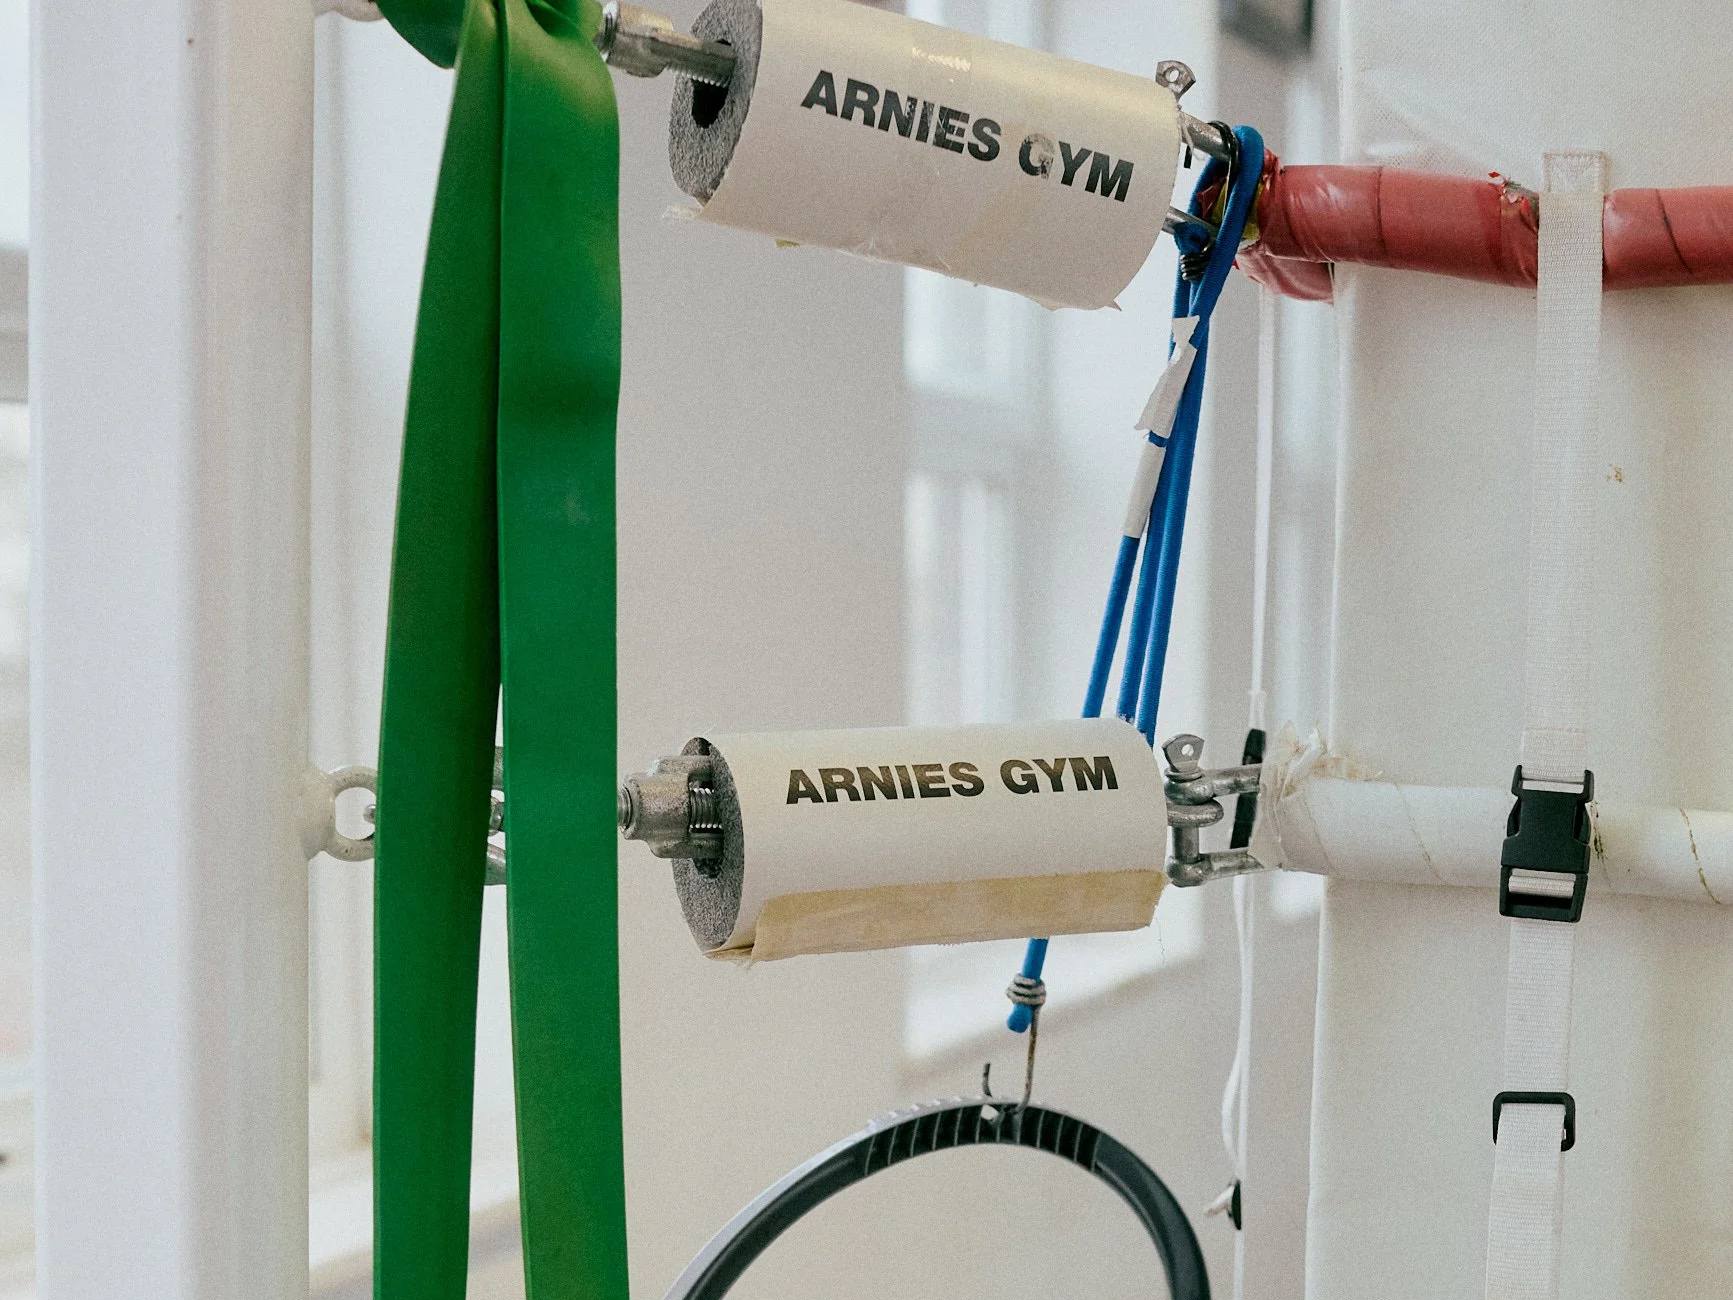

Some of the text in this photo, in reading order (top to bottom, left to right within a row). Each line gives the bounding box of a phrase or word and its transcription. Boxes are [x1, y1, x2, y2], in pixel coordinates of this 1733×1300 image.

[801, 69, 1135, 203] ARNIES GYM
[786, 756, 1119, 805] ARNIES GYM
